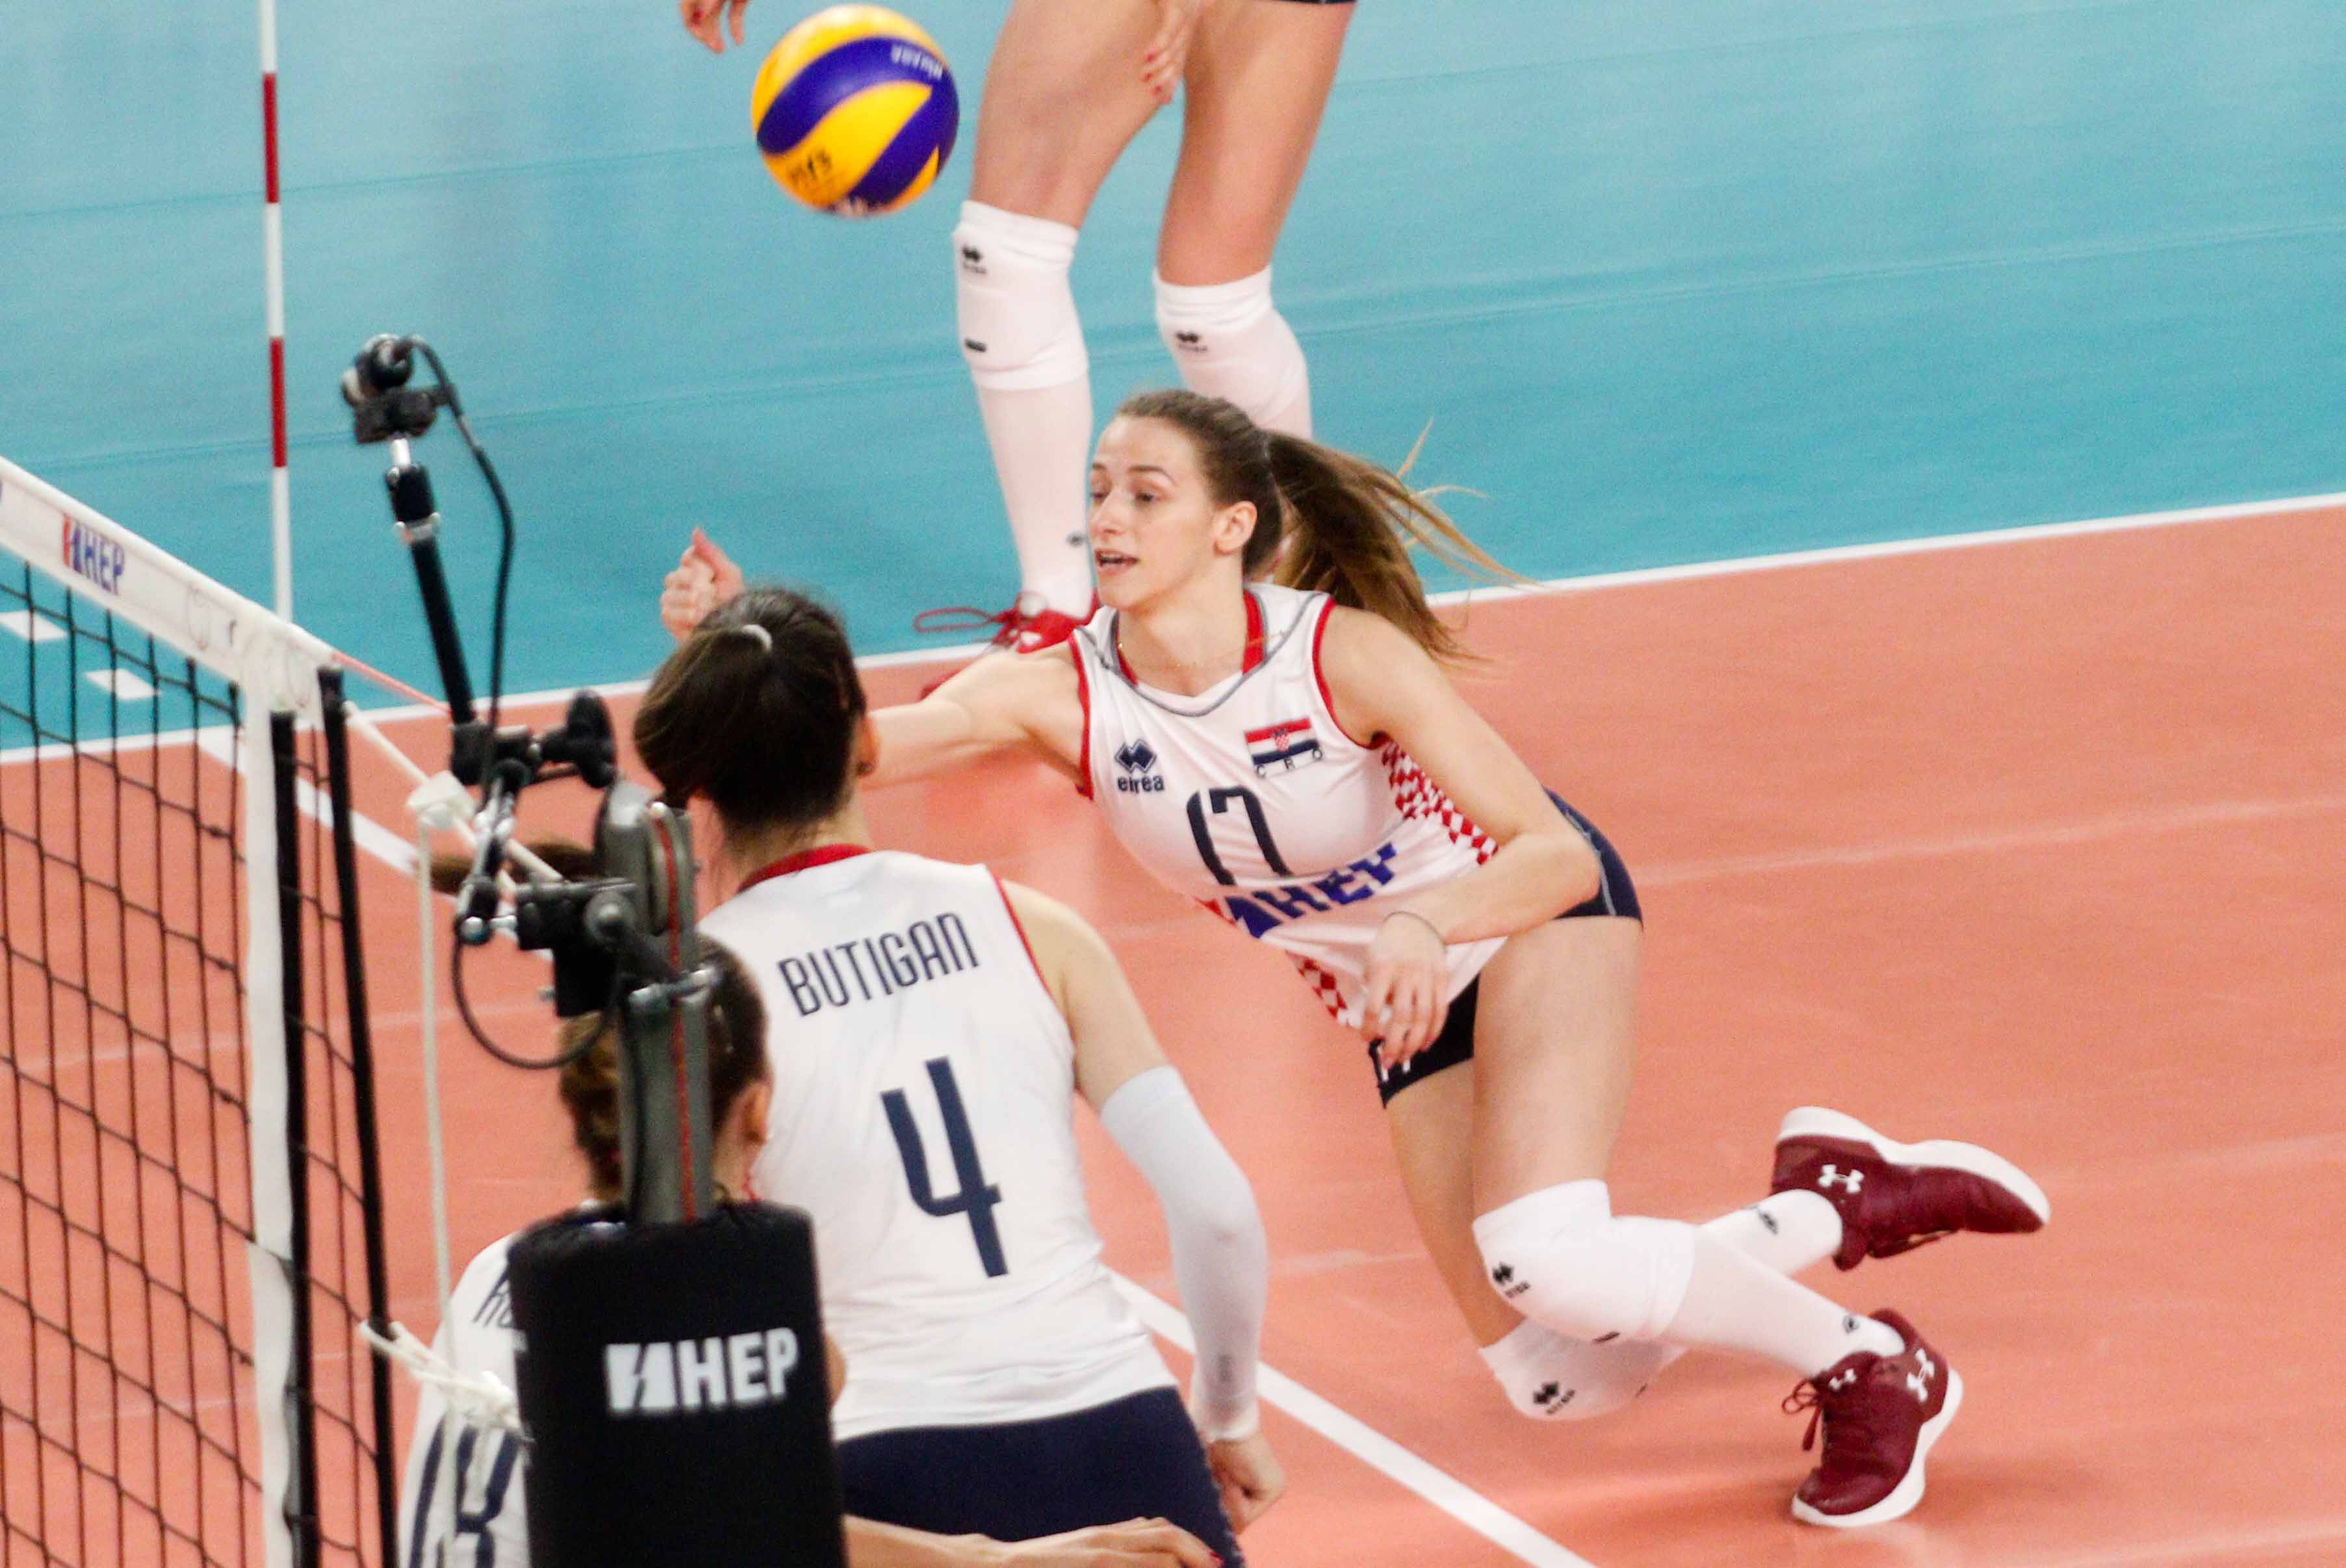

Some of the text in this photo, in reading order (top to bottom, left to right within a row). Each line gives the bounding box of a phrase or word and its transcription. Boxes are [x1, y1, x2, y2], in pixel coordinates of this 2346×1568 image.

[1187, 785, 1292, 886] 17
[776, 911, 979, 1016] BUTIGAN
[880, 1055, 1009, 1278] 4
[676, 1326, 799, 1410] HEP
